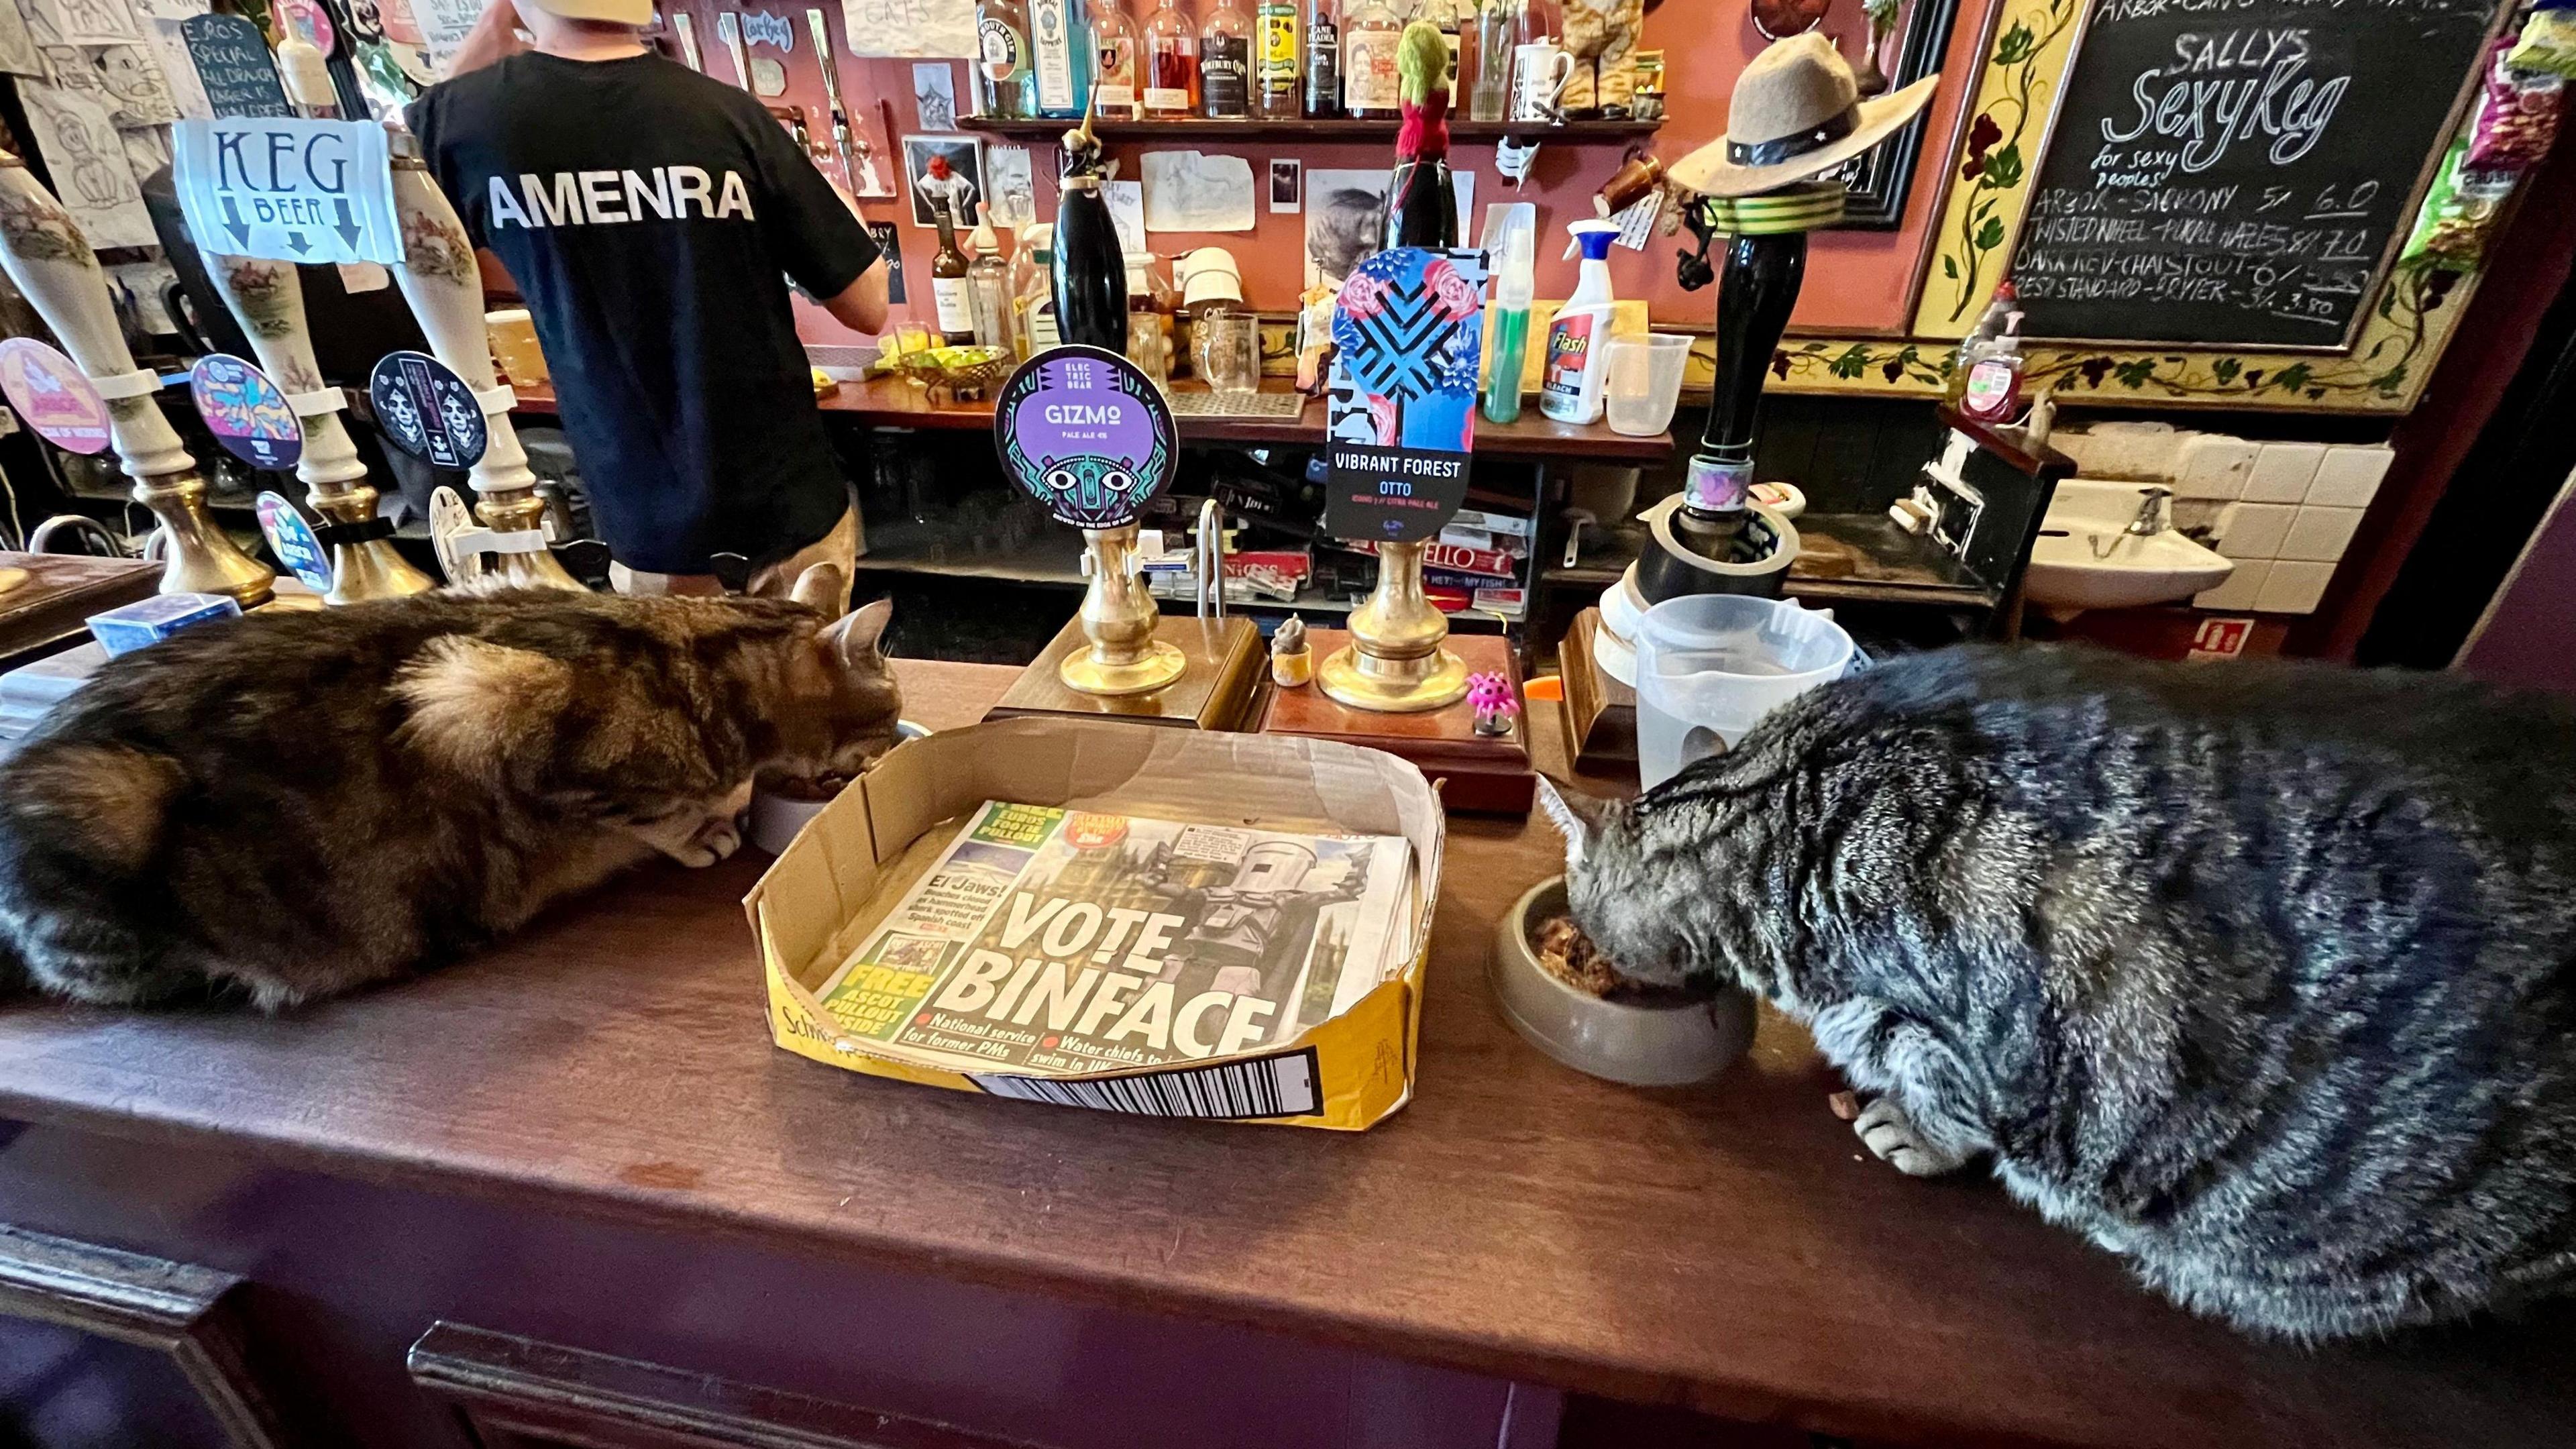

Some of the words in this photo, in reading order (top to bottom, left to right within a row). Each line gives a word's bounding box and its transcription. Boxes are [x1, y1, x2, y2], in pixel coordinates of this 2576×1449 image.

[213, 131, 349, 194] KEG
[2091, 145, 2119, 169] for
[2128, 149, 2178, 179] sexy
[488, 165, 756, 229] AMENRA
[252, 197, 325, 226] BEER
[1553, 331, 1588, 354] Flash
[1045, 405, 1122, 425] GIZMO
[1335, 452, 1399, 473] VIBRANT
[1403, 458, 1462, 478] FOREST
[1379, 480, 1411, 496] OTTO
[998, 809, 1046, 826] EUROS
[977, 826, 1044, 843] PULLOUT
[928, 874, 947, 890] El
[951, 878, 1010, 899] Jaws!
[907, 912, 945, 924] Spanish
[945, 919, 972, 930] coast
[934, 908, 971, 919] spotted
[999, 891, 1185, 975] VOTE
[841, 963, 935, 998] FREE
[824, 998, 904, 1024] PULLOUT
[842, 989, 905, 1010] ASCOT
[933, 948, 1277, 1059] BINFACE
[903, 1026, 925, 1042] for
[927, 1033, 975, 1053] former
[976, 1041, 1010, 1058] PMs
[930, 1012, 990, 1036] National
[991, 1028, 1036, 1046] service
[1030, 1051, 1071, 1067] swim
[1071, 1054, 1085, 1070] in
[1058, 1035, 1104, 1057] Water
[1104, 1044, 1143, 1063] chiefs
[1146, 1049, 1163, 1064] to
